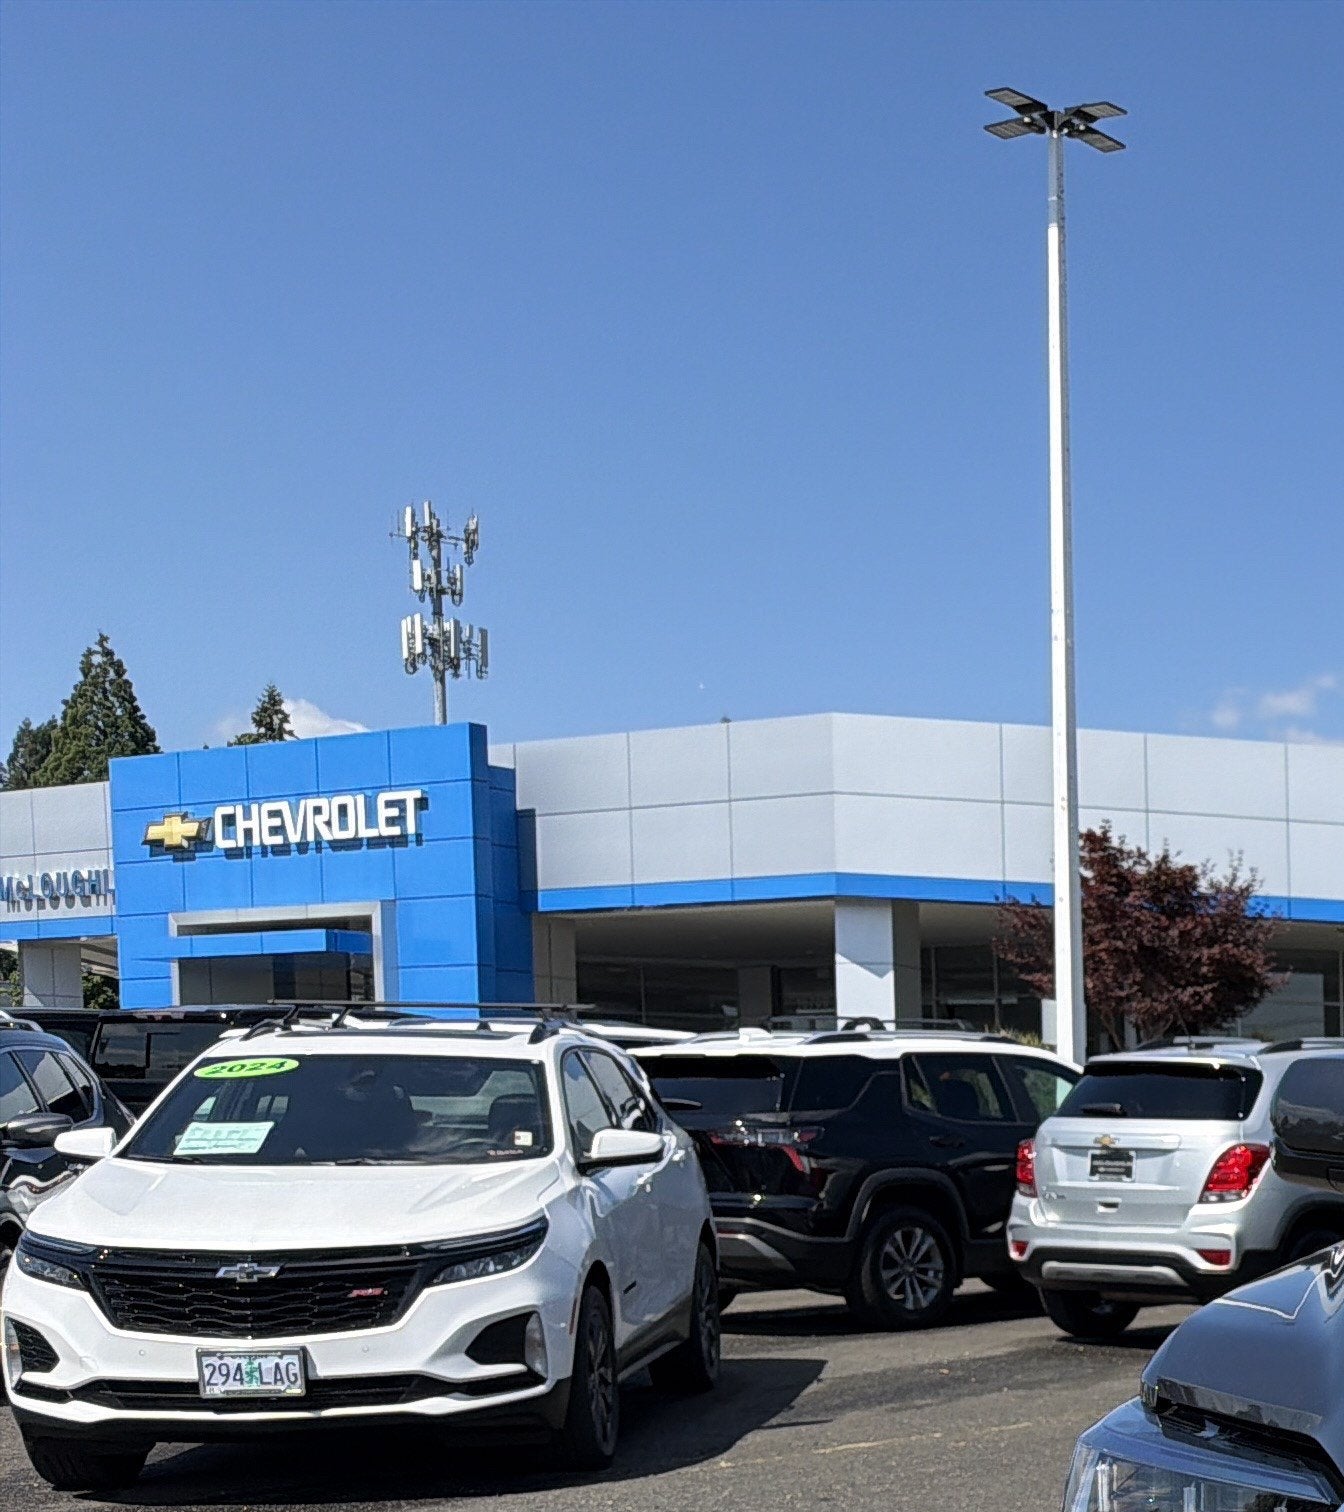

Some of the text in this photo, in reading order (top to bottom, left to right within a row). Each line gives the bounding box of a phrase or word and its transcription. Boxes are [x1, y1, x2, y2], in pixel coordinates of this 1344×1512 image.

[214, 788, 422, 849] CHEVROLET
[204, 1060, 288, 1075] 2024
[205, 1361, 299, 1386] 294 LAG
